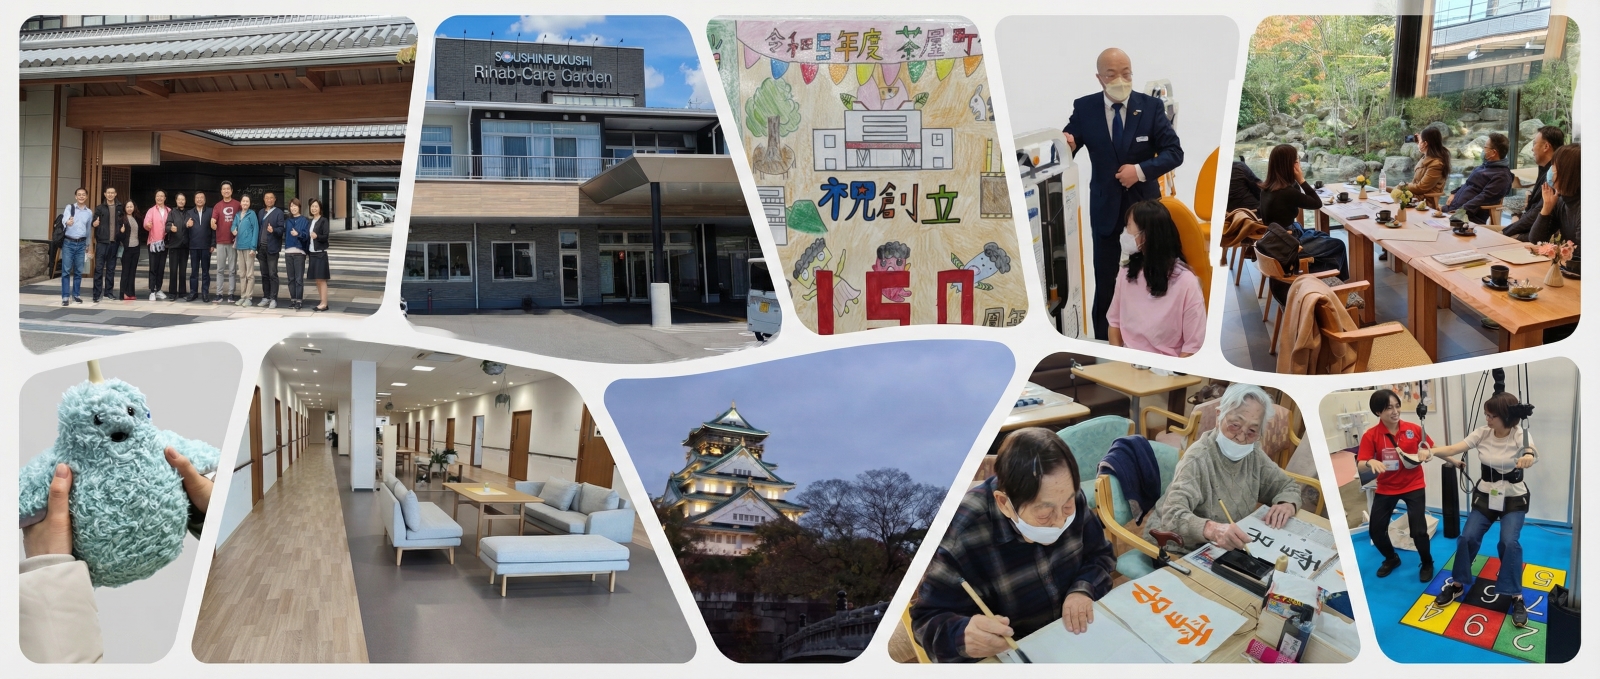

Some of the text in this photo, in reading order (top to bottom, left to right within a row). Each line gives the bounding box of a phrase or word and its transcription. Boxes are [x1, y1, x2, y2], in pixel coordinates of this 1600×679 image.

[765, 25, 981, 62] 令和5年度 茶屋町
[495, 51, 592, 66] SOUSHINFUKUSHI
[474, 65, 612, 83] Rihab-Care Garden
[818, 177, 961, 224] 祝創立
